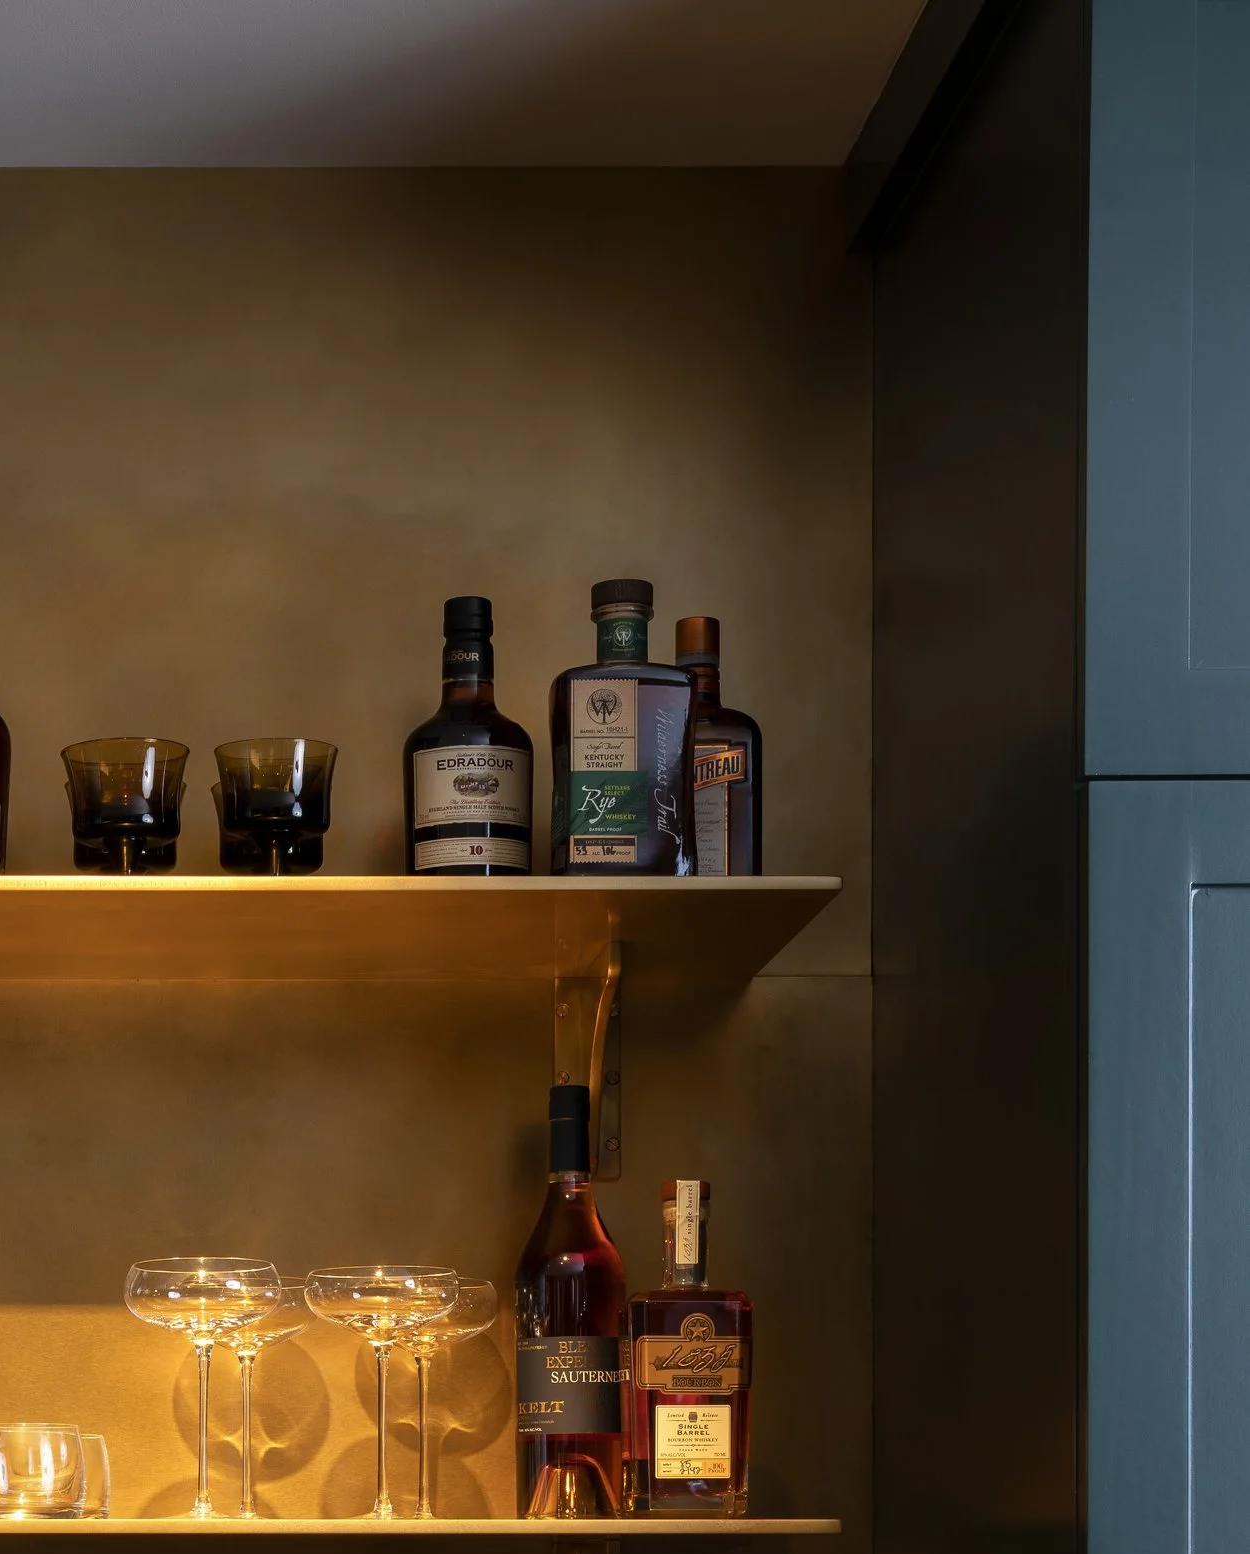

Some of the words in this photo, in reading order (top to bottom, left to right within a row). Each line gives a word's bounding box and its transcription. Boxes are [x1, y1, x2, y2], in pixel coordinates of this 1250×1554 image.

[437, 758, 514, 771] EDRADOUR
[586, 761, 623, 769] STRAIGHT
[577, 785, 617, 824] Rye
[470, 846, 483, 856] 10
[686, 1212, 694, 1234] single
[673, 1377, 722, 1387] BOURBON
[518, 1401, 564, 1414] KELT
